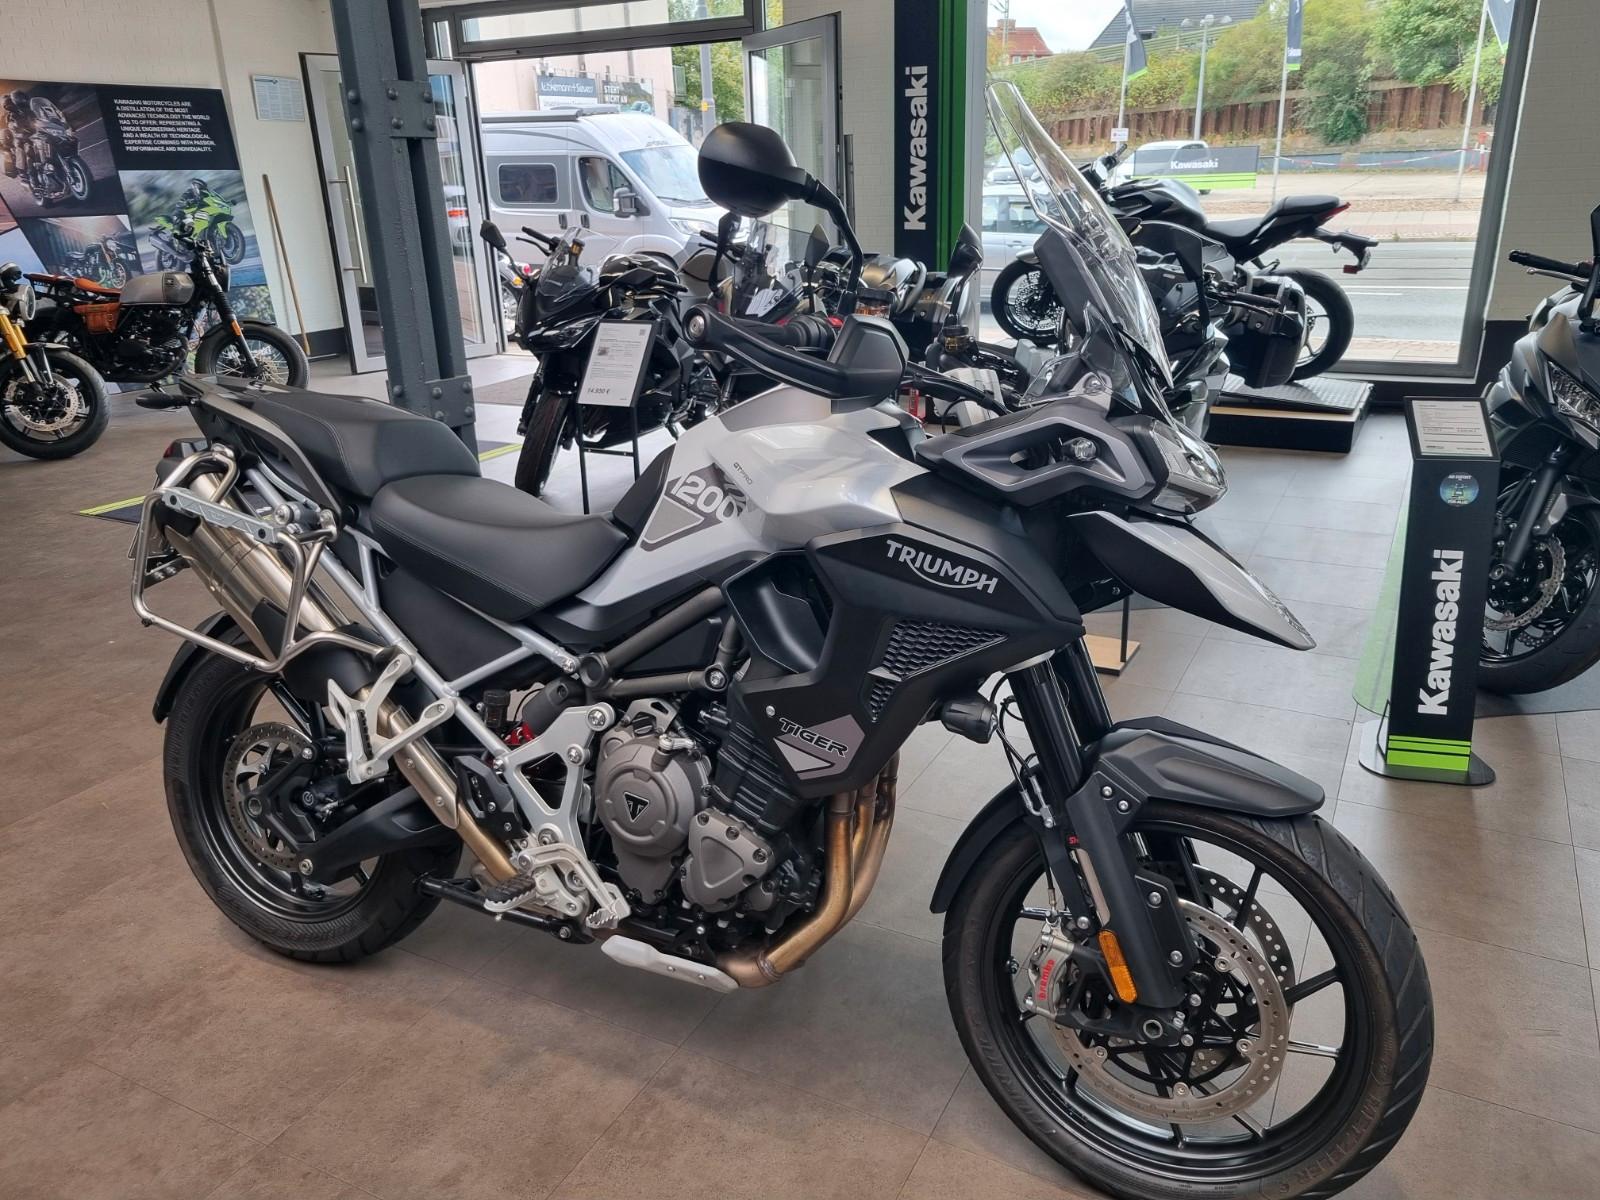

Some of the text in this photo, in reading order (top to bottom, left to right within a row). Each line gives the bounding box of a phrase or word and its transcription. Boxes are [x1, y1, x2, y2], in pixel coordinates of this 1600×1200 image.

[904, 65, 928, 230] Kawasaki
[1170, 158, 1219, 170] Kawasaki
[670, 474, 738, 522] 1200
[886, 539, 999, 594] TRIUMPH
[1417, 549, 1464, 716] Kawasaki
[779, 717, 849, 758] TIGER
